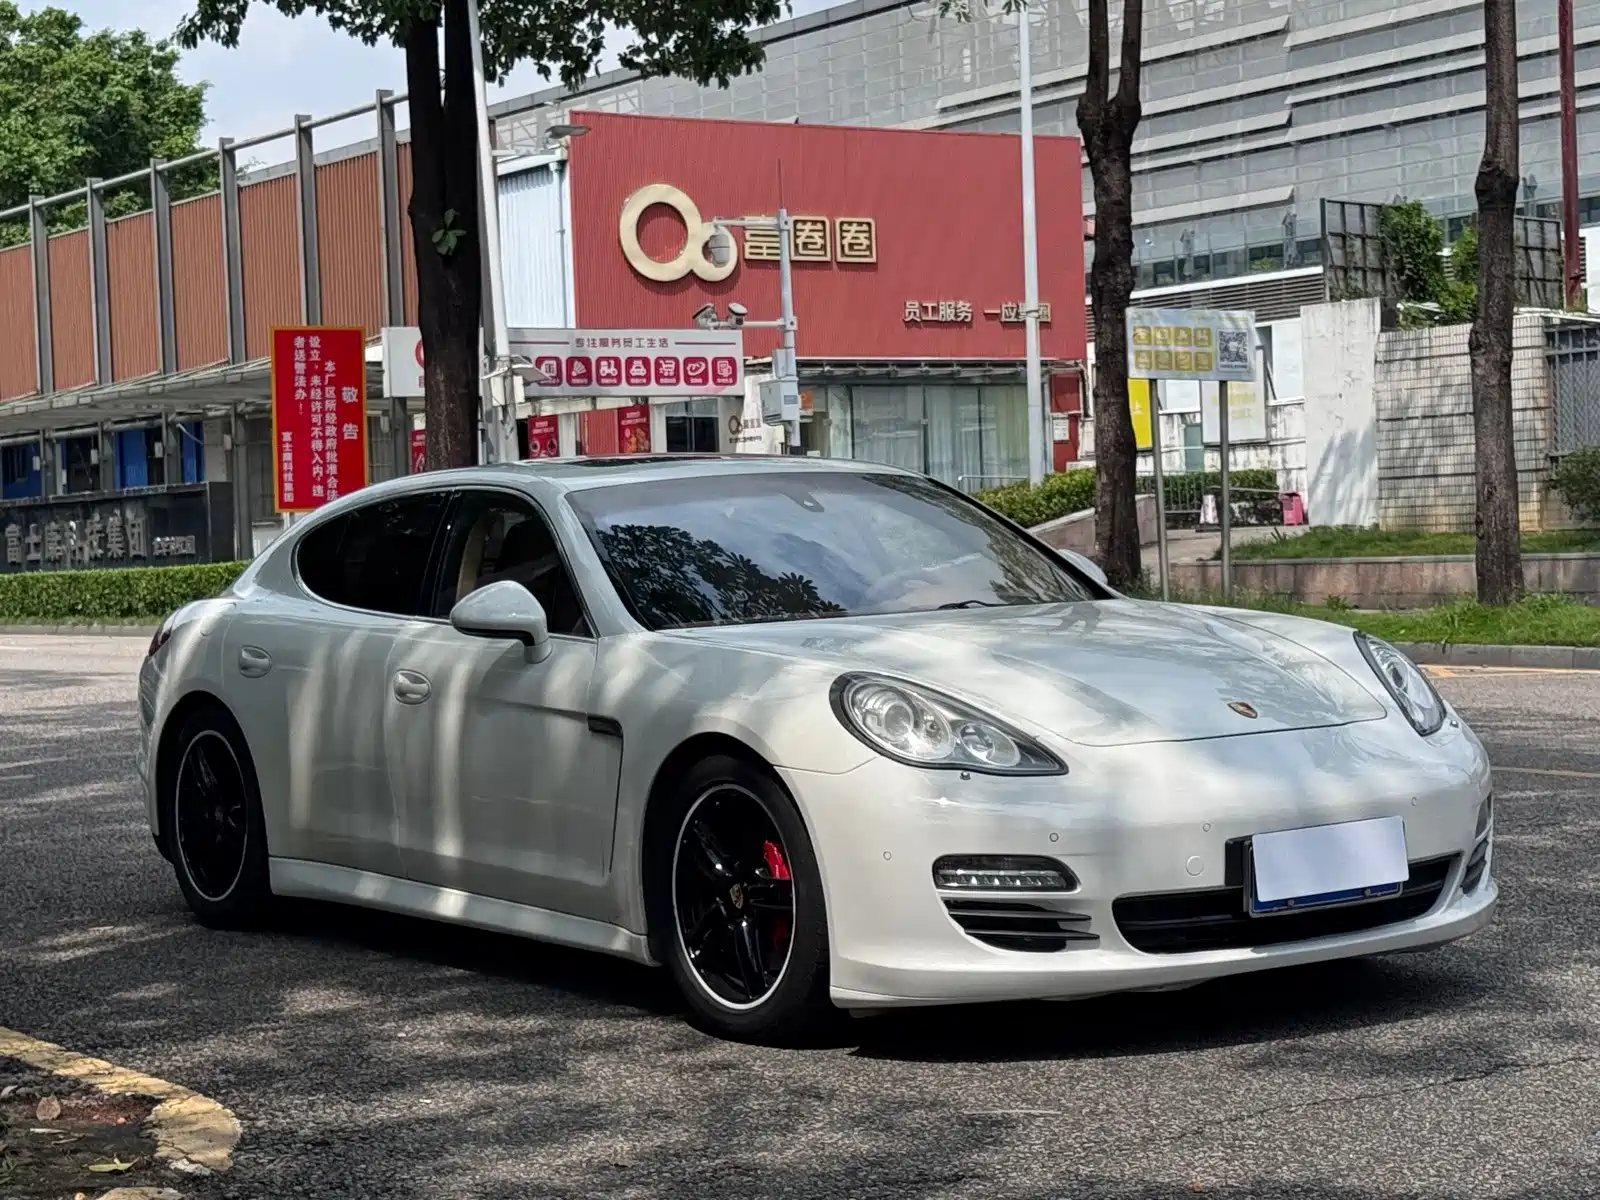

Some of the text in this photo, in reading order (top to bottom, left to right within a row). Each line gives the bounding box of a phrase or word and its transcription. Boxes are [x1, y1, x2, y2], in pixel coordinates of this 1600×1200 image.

[744, 215, 877, 263] 富圈圈
[904, 300, 973, 322] 员工服务
[574, 337, 669, 349] 专注服务员工生活
[341, 386, 359, 440] 敬告
